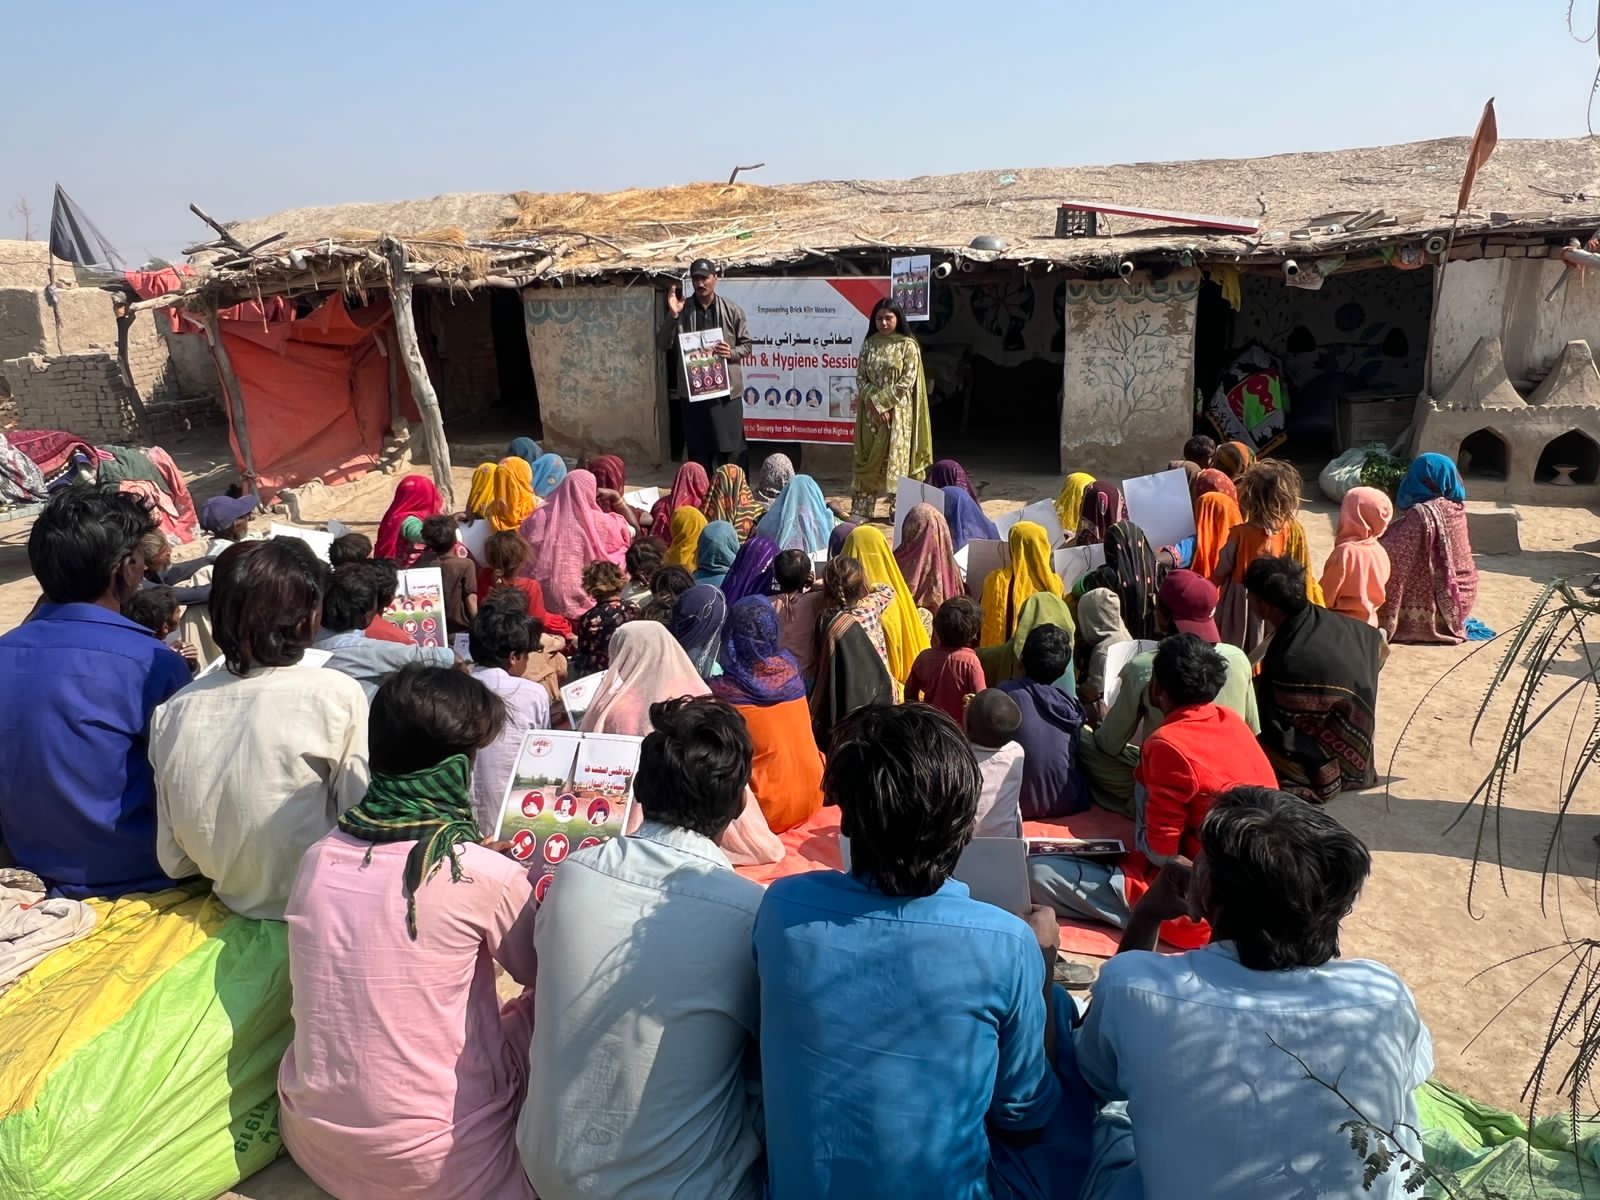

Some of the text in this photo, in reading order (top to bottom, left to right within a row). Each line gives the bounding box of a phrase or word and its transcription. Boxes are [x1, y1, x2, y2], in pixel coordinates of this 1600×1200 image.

[742, 352, 858, 370] lth & Hygiene Sessio
